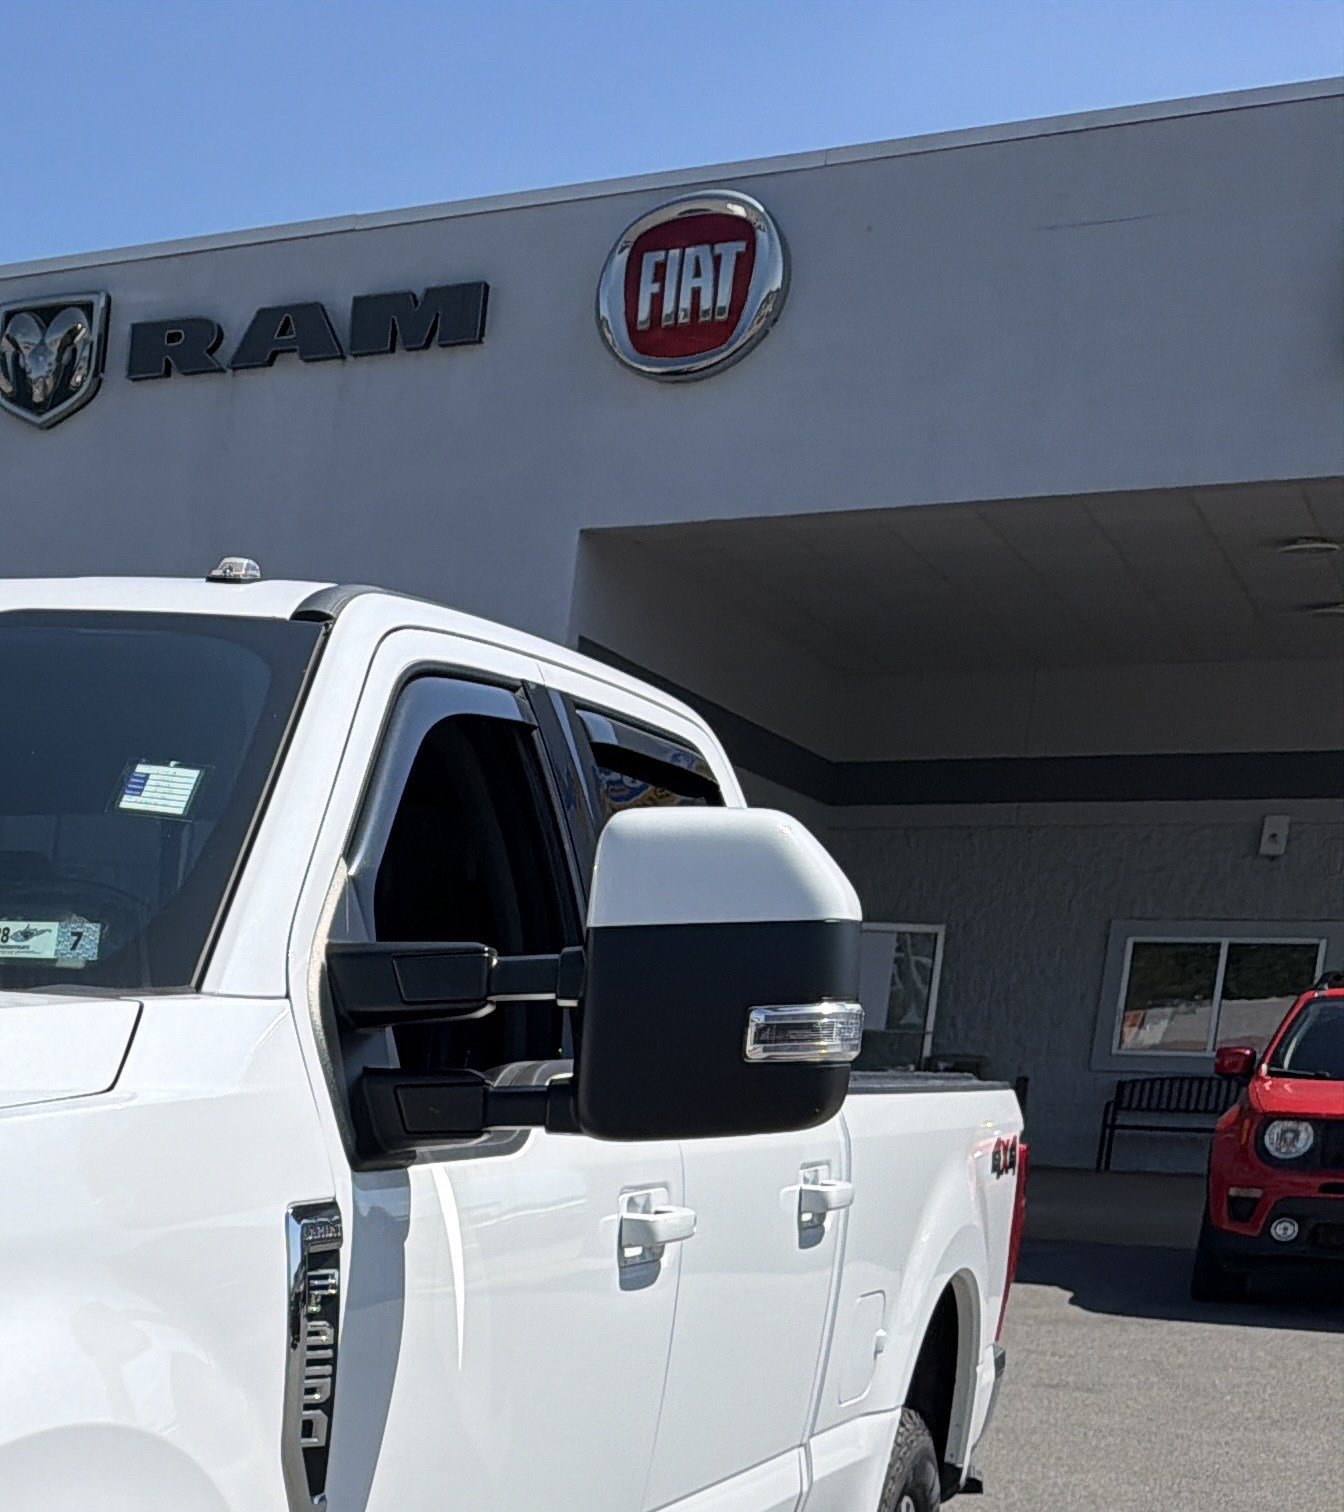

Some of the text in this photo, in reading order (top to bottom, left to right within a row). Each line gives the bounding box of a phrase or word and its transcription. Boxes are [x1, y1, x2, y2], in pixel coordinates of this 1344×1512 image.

[126, 281, 490, 380] RAM
[637, 240, 747, 331] FIAT
[69, 931, 84, 952] 7
